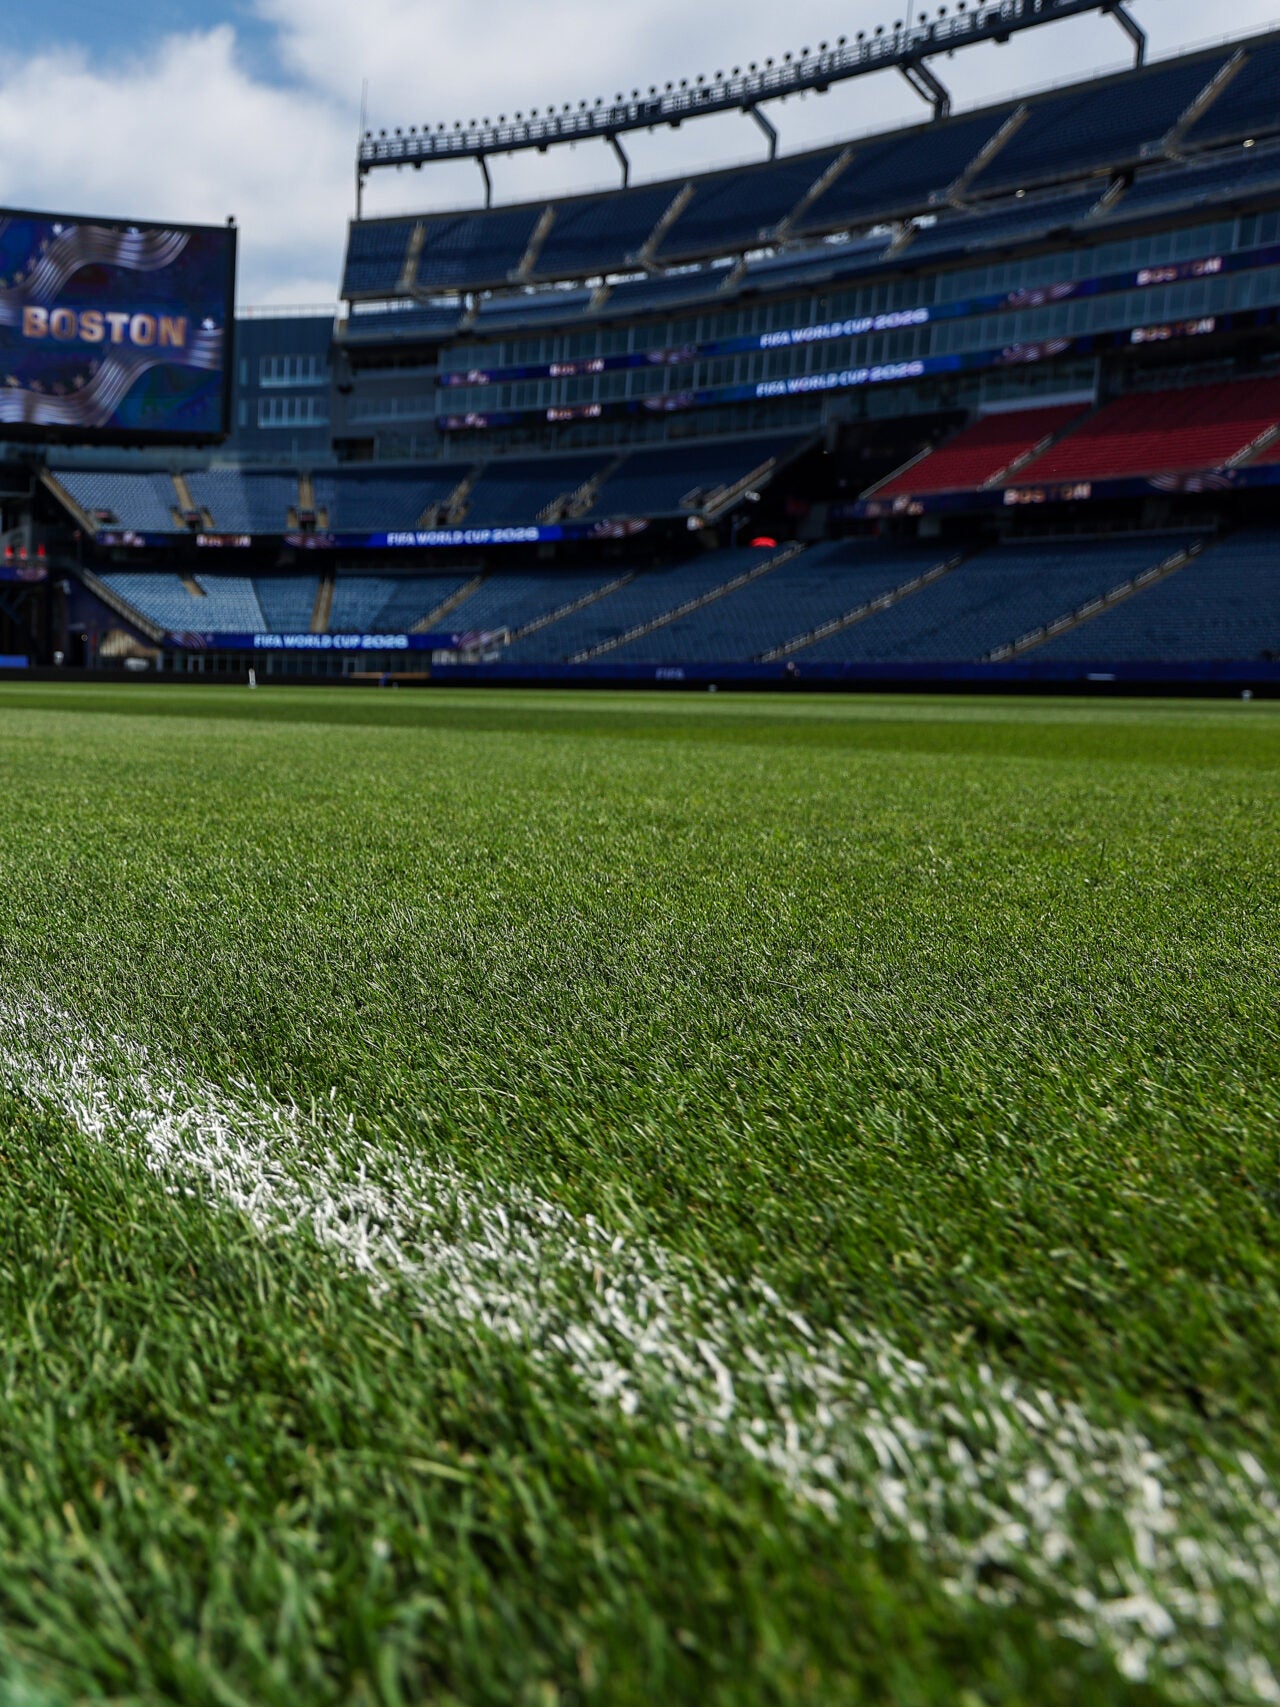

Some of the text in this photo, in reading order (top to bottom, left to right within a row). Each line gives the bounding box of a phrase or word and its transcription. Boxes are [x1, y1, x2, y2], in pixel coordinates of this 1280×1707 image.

[22, 306, 187, 347] BOSTON
[760, 331, 791, 349] FIFA
[791, 322, 842, 343] WORLD
[843, 317, 873, 336] CUP
[756, 381, 787, 398] FIFA
[787, 373, 839, 393] WORLD
[839, 367, 869, 386] CUP
[387, 526, 539, 546] FIFA WORLD CUP 2026
[254, 633, 409, 649] FIFA WORLD CUP 2026
